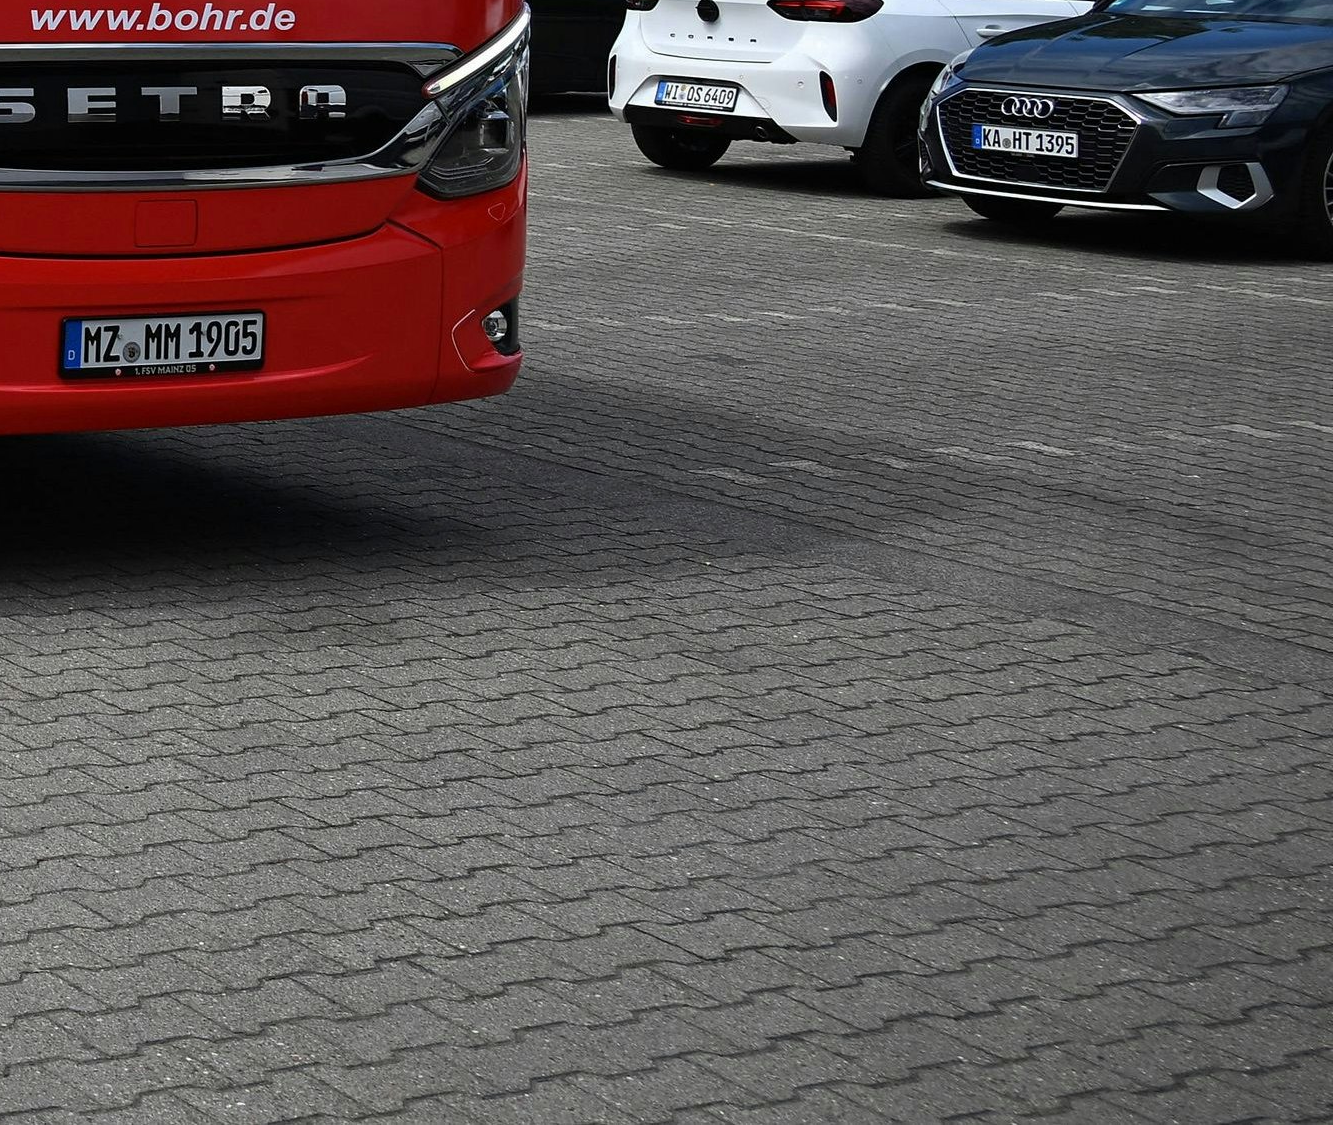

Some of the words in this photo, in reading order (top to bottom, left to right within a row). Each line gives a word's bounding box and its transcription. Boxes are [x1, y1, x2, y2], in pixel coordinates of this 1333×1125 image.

[30, 2, 296, 30] www.bohr.de
[665, 83, 679, 100] WI
[687, 86, 703, 102] OS
[704, 88, 735, 105] 6409
[983, 128, 1001, 147] KA
[1013, 131, 1032, 150] HT
[1035, 133, 1074, 155] 1395
[68, 350, 76, 360] D
[84, 325, 120, 363] MZ
[144, 323, 181, 360] MM
[188, 319, 258, 358] 1905
[142, 367, 156, 375] FSV
[157, 365, 184, 374] MAINZ
[185, 365, 196, 373] 05
